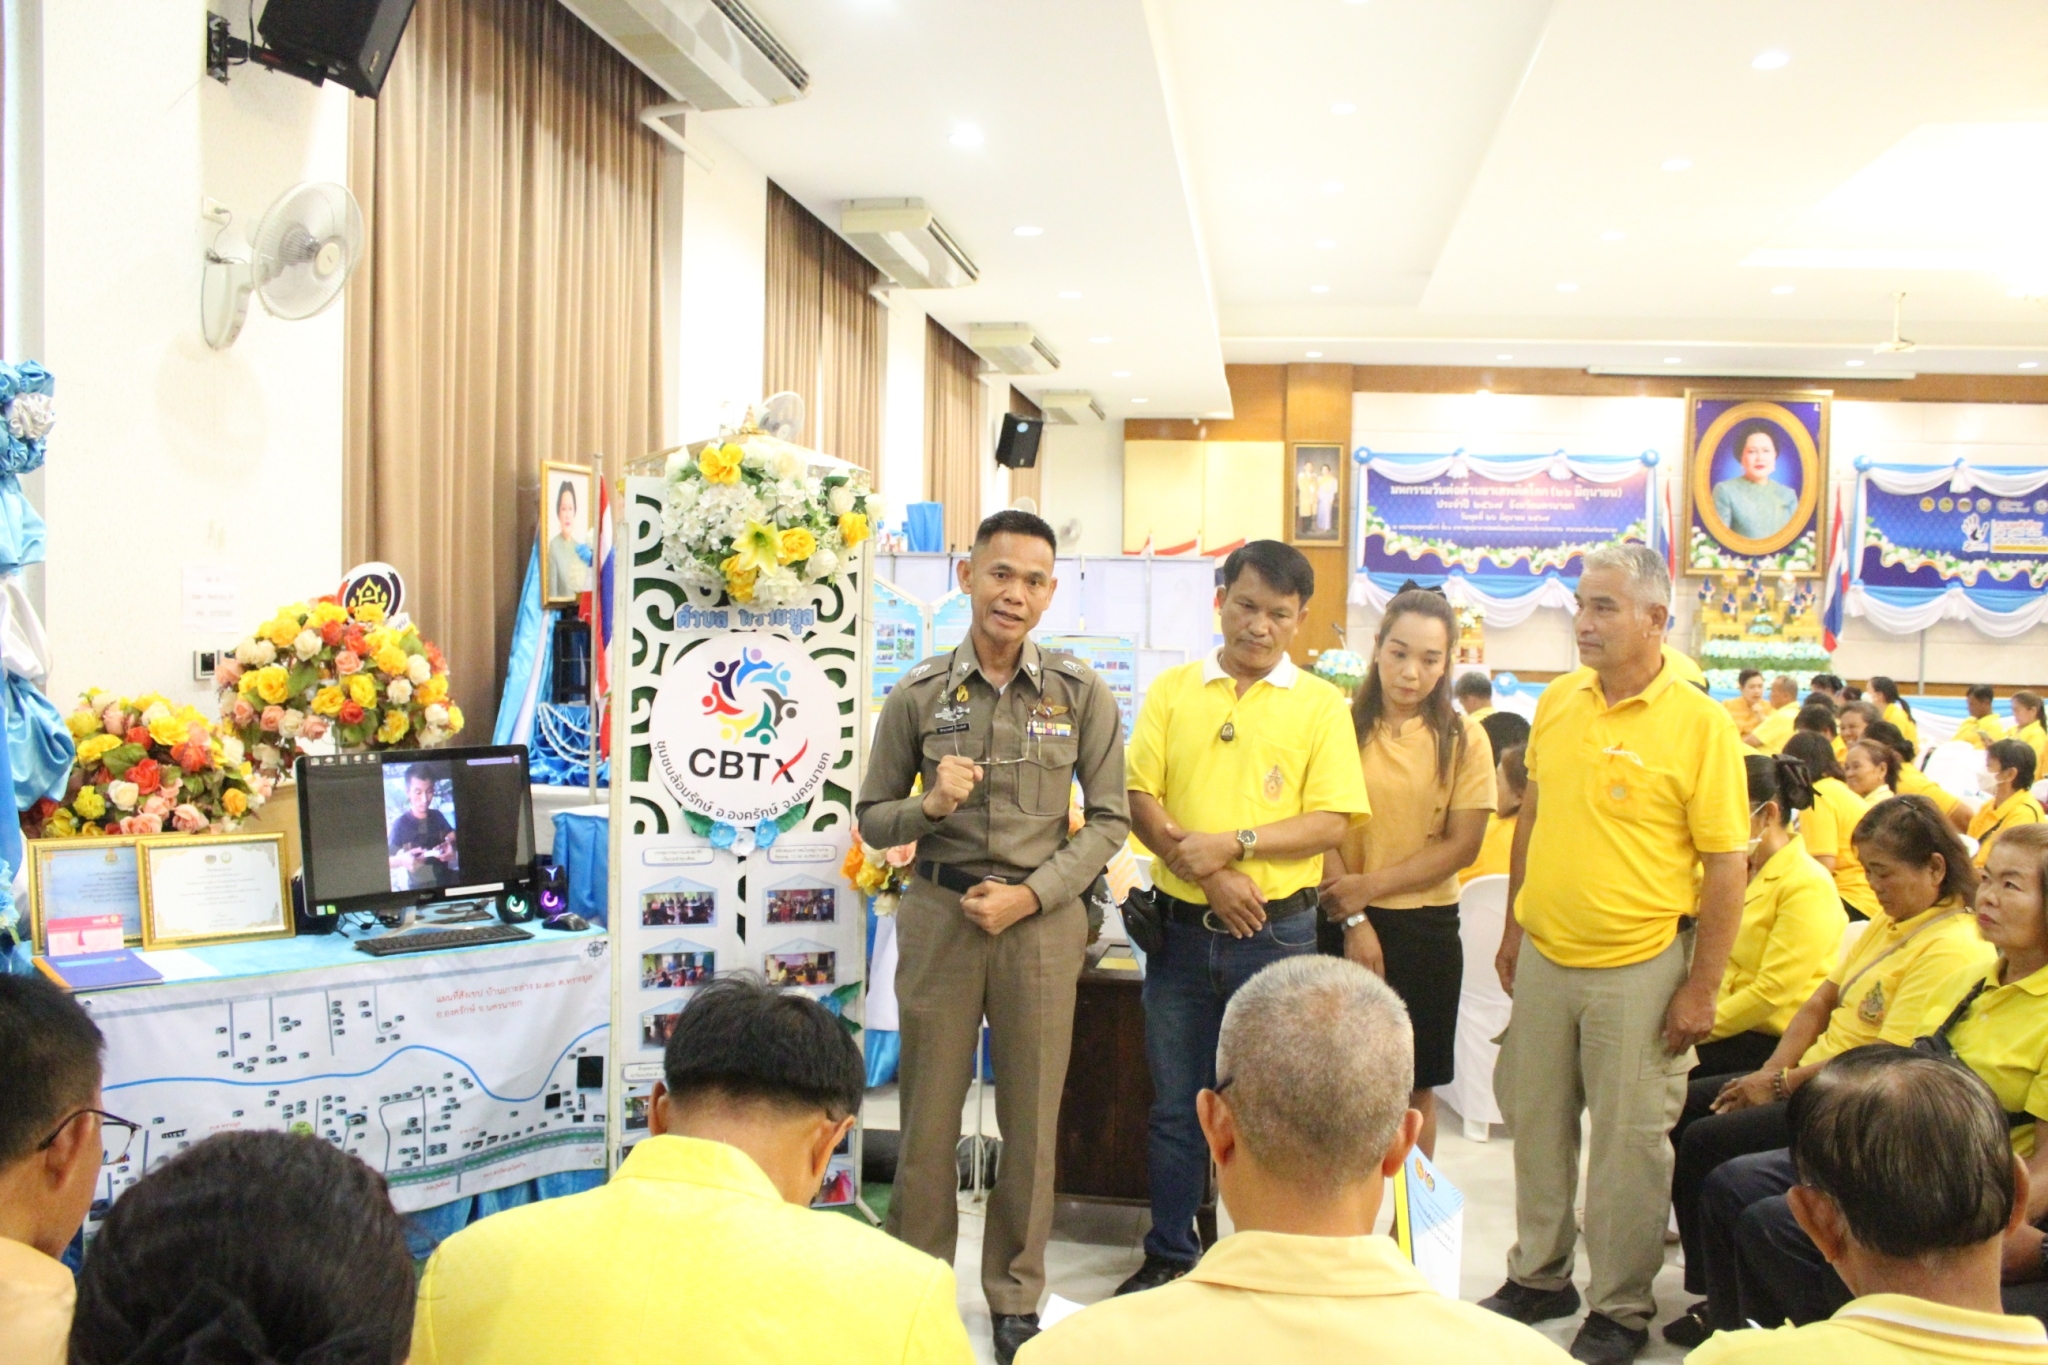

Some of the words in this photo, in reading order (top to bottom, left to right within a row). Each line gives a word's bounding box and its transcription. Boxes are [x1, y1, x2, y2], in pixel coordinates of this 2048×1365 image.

[677, 604, 728, 628] ตำบล
[738, 607, 813, 635] ทรายมูล
[653, 740, 714, 813] ชุมชนล้อมรักษ์
[716, 803, 778, 821] อ.องครักษ์
[782, 752, 831, 809] จ.นครนายก
